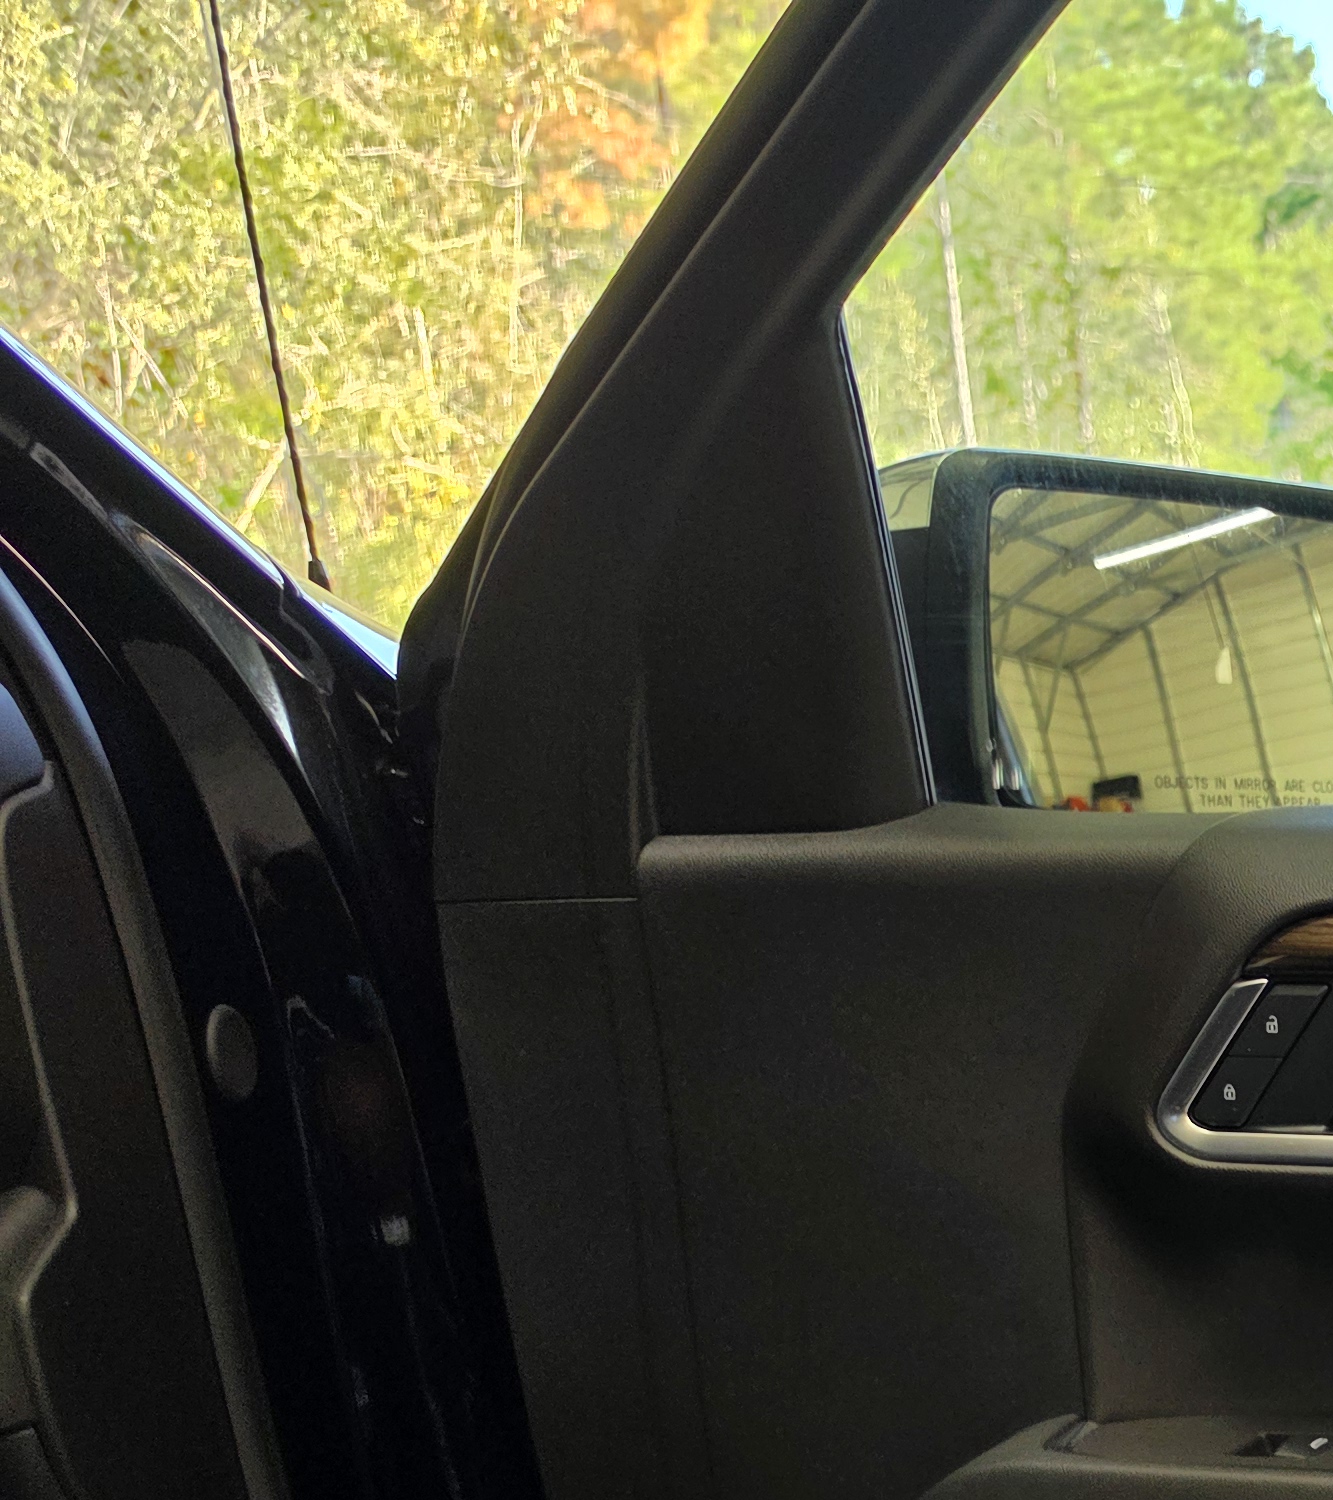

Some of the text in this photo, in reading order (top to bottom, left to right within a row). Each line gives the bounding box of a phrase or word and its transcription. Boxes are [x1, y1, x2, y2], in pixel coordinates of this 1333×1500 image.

[1154, 775, 1209, 790] OBJECTS
[1215, 777, 1227, 790] IN
[1234, 777, 1277, 791] MIRROR
[1285, 779, 1305, 793] ARE
[1200, 794, 1233, 807] THAN
[1240, 795, 1270, 809] THEY
